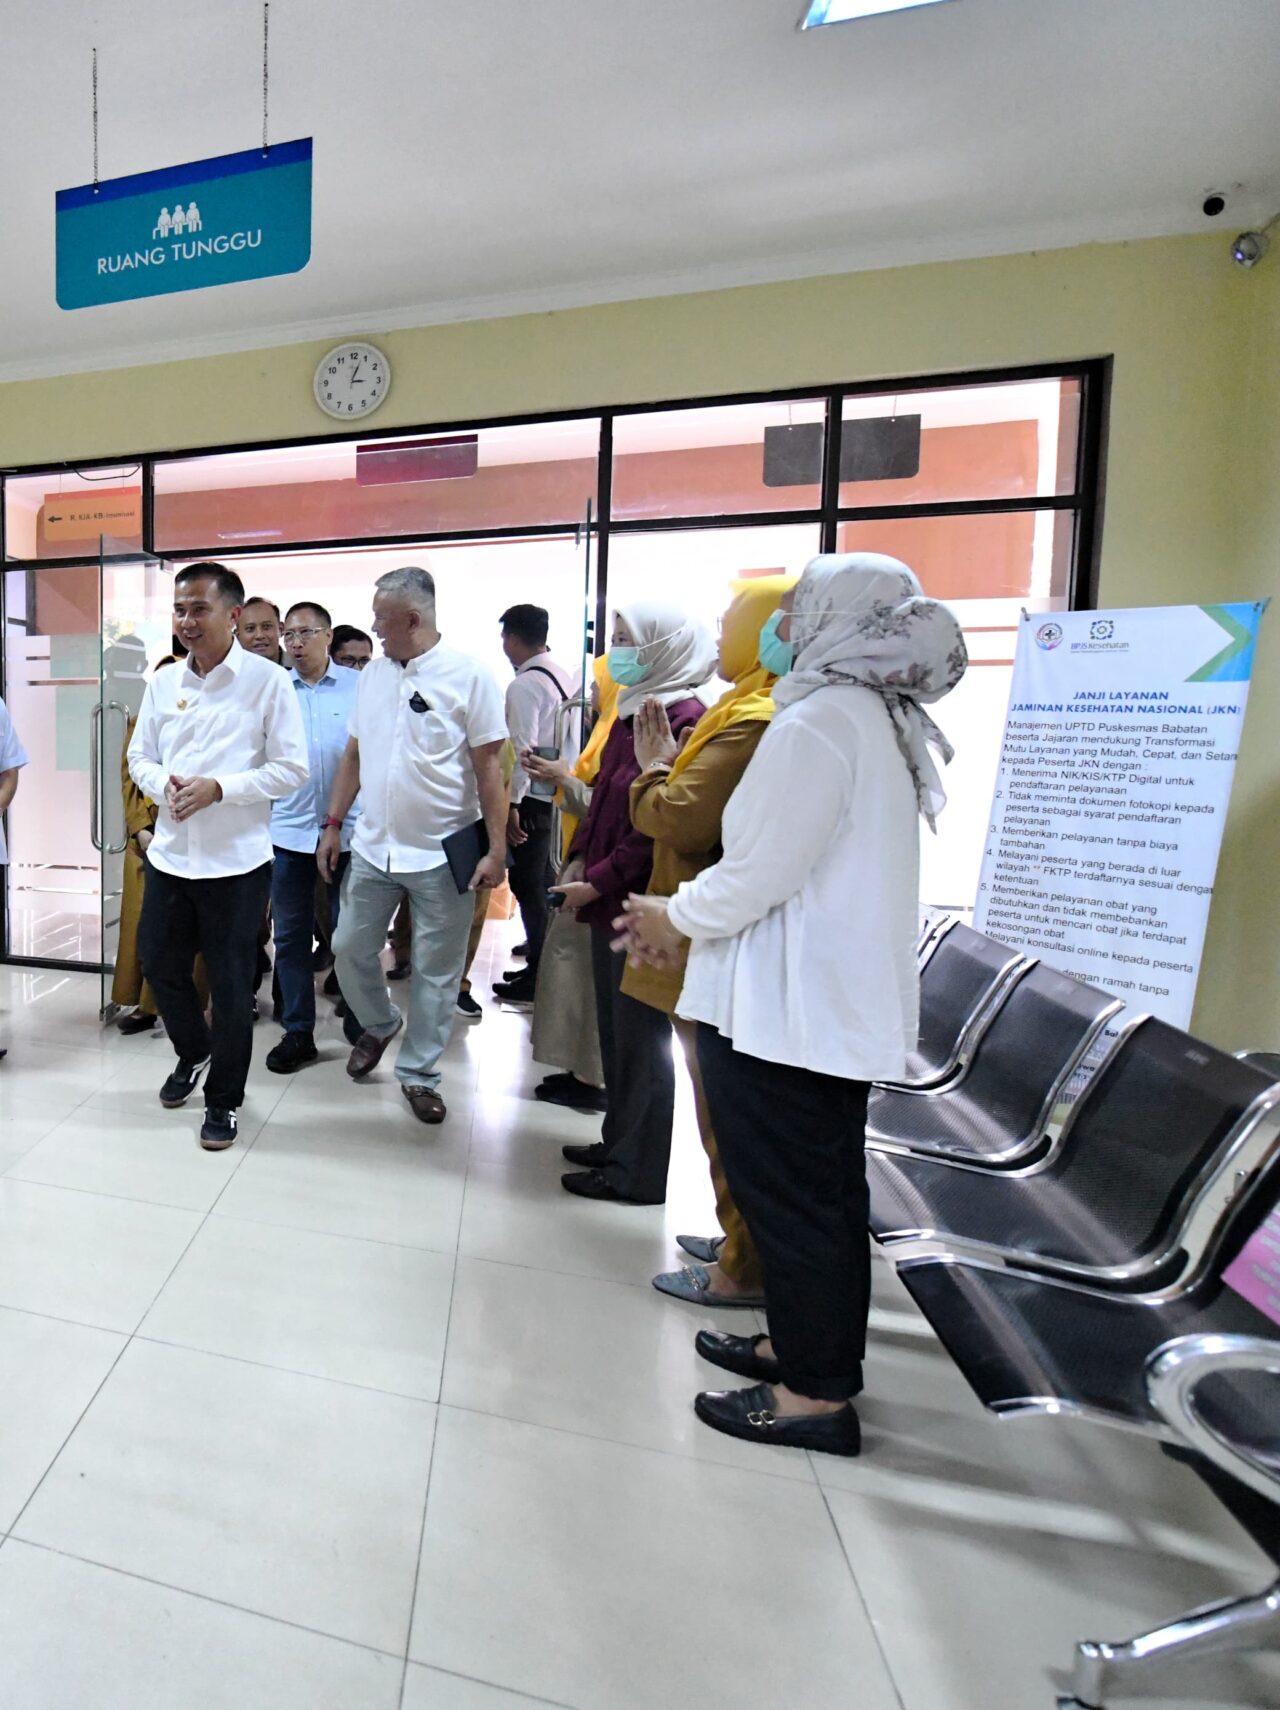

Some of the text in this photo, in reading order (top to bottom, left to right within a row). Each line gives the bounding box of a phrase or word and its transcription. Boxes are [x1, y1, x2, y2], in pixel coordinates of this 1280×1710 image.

[97, 229, 262, 275] RUANG TUNGGU
[350, 352, 358, 360] 12
[328, 366, 337, 374] 10
[372, 363, 378, 371] 2
[323, 379, 329, 387] 9
[376, 376, 381, 384] 3
[327, 392, 332, 400] 8
[371, 389, 376, 397] 4
[348, 403, 353, 411] 6
[361, 399, 366, 407] 5
[1073, 691, 1168, 700] JANJI LAYANAN
[1011, 704, 1063, 712] JAMINAN
[1066, 704, 1133, 713] KESEHATAN
[1137, 705, 1203, 714] NASIONAL
[1008, 721, 1208, 733] Manajemen UPTD Puskesmas Babatan
[1006, 733, 1216, 747] beserta Jajaran mendukung Transformasi
[1004, 744, 1026, 753] Mutu
[1029, 745, 1070, 755] Layanan
[1073, 748, 1097, 758] yang
[1181, 751, 1201, 760] dan
[1002, 756, 1035, 765] kepada
[1038, 757, 1075, 767] Peserta
[1078, 759, 1099, 768] JKN
[1103, 761, 1141, 772] dengan
[1011, 768, 1057, 778] Menerima
[1061, 771, 1126, 781] NIK/KIS/KTP
[1129, 774, 1162, 785] Digital
[1165, 777, 1195, 786] untuk
[1009, 781, 1065, 791] pendaftaran
[1009, 791, 1032, 800] Tidak
[1034, 794, 1076, 804] meminta
[1079, 797, 1126, 807] dokumen
[1129, 800, 1171, 812] fotokopi
[1174, 803, 1215, 814] kepada
[1004, 815, 1050, 826] pelayanan
[1005, 804, 1182, 825] peserta sebagai syarat pendaftaran
[1000, 838, 1045, 850] tambahan
[1002, 826, 1058, 839] Memberikan
[1061, 833, 1113, 845] pelayanan
[1117, 837, 1146, 848] tanpa
[1149, 840, 1178, 852] biaya
[998, 849, 1039, 861] Melayani
[1041, 855, 1077, 866] peserta
[1081, 860, 1106, 871] yang
[1108, 861, 1145, 874] berada
[1148, 865, 1157, 875] di
[1161, 867, 1182, 877] luar
[994, 873, 1039, 885] ketentuan
[996, 862, 1030, 873] wilayah
[1043, 866, 1071, 877] FKTP
[1074, 870, 1135, 887] terdaftarnya
[1138, 879, 1174, 890] sesuai
[992, 884, 1048, 899] Memberikan
[1051, 893, 1103, 907] pelayanan
[1105, 900, 1128, 910] obat
[1131, 904, 1158, 916] yang
[990, 896, 1168, 929] dibutuhkan dan tidak membebankan
[986, 919, 1065, 939] kekosongan obat
[988, 908, 1187, 945] peserta untuk mencari obat jika terdapat
[1027, 938, 1075, 953] konsultasi
[1077, 946, 1108, 959] online
[1111, 951, 1150, 966] kepada
[1153, 960, 1193, 973] peserta
[1103, 977, 1136, 989] ramah
[1139, 983, 1170, 996] tanpa
